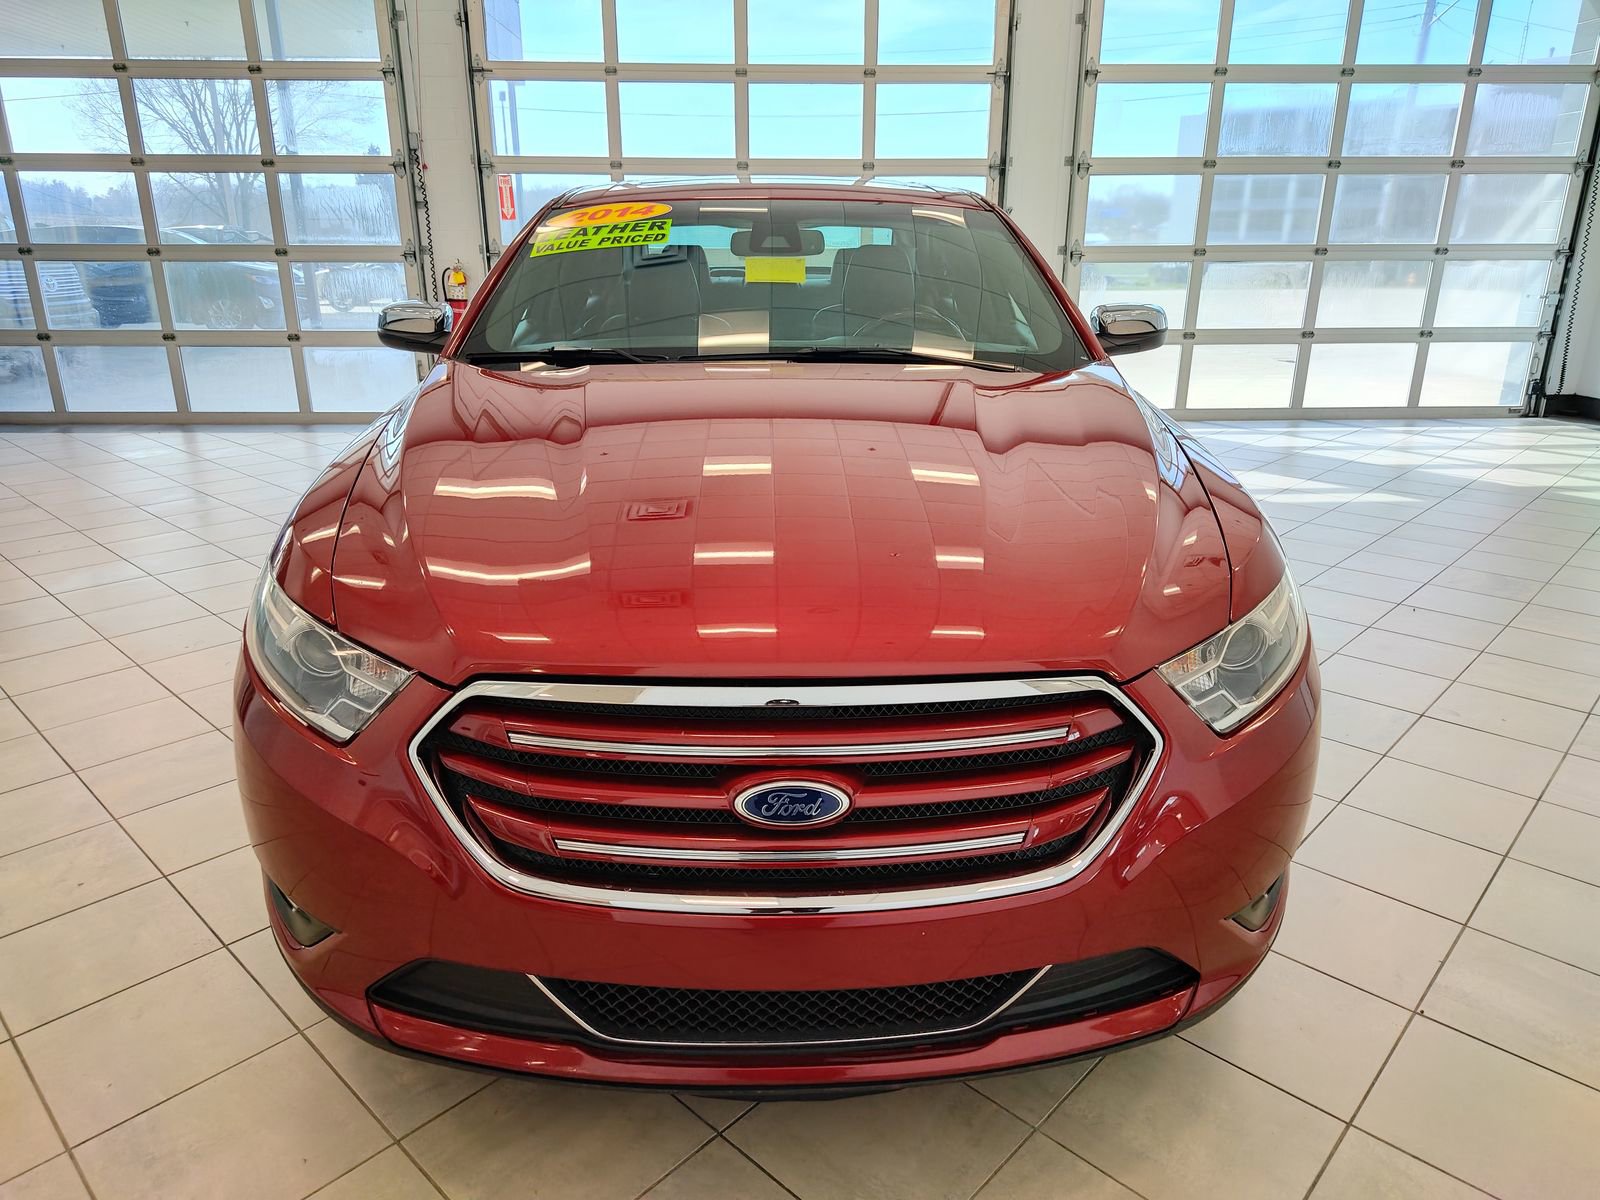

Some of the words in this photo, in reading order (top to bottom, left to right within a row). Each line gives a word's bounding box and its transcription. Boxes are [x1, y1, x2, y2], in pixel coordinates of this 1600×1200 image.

[569, 206, 656, 222] 2014
[543, 221, 667, 242] EATHER
[536, 239, 591, 254] VALUE
[597, 233, 666, 246] PRICED
[761, 792, 823, 816] Ford
